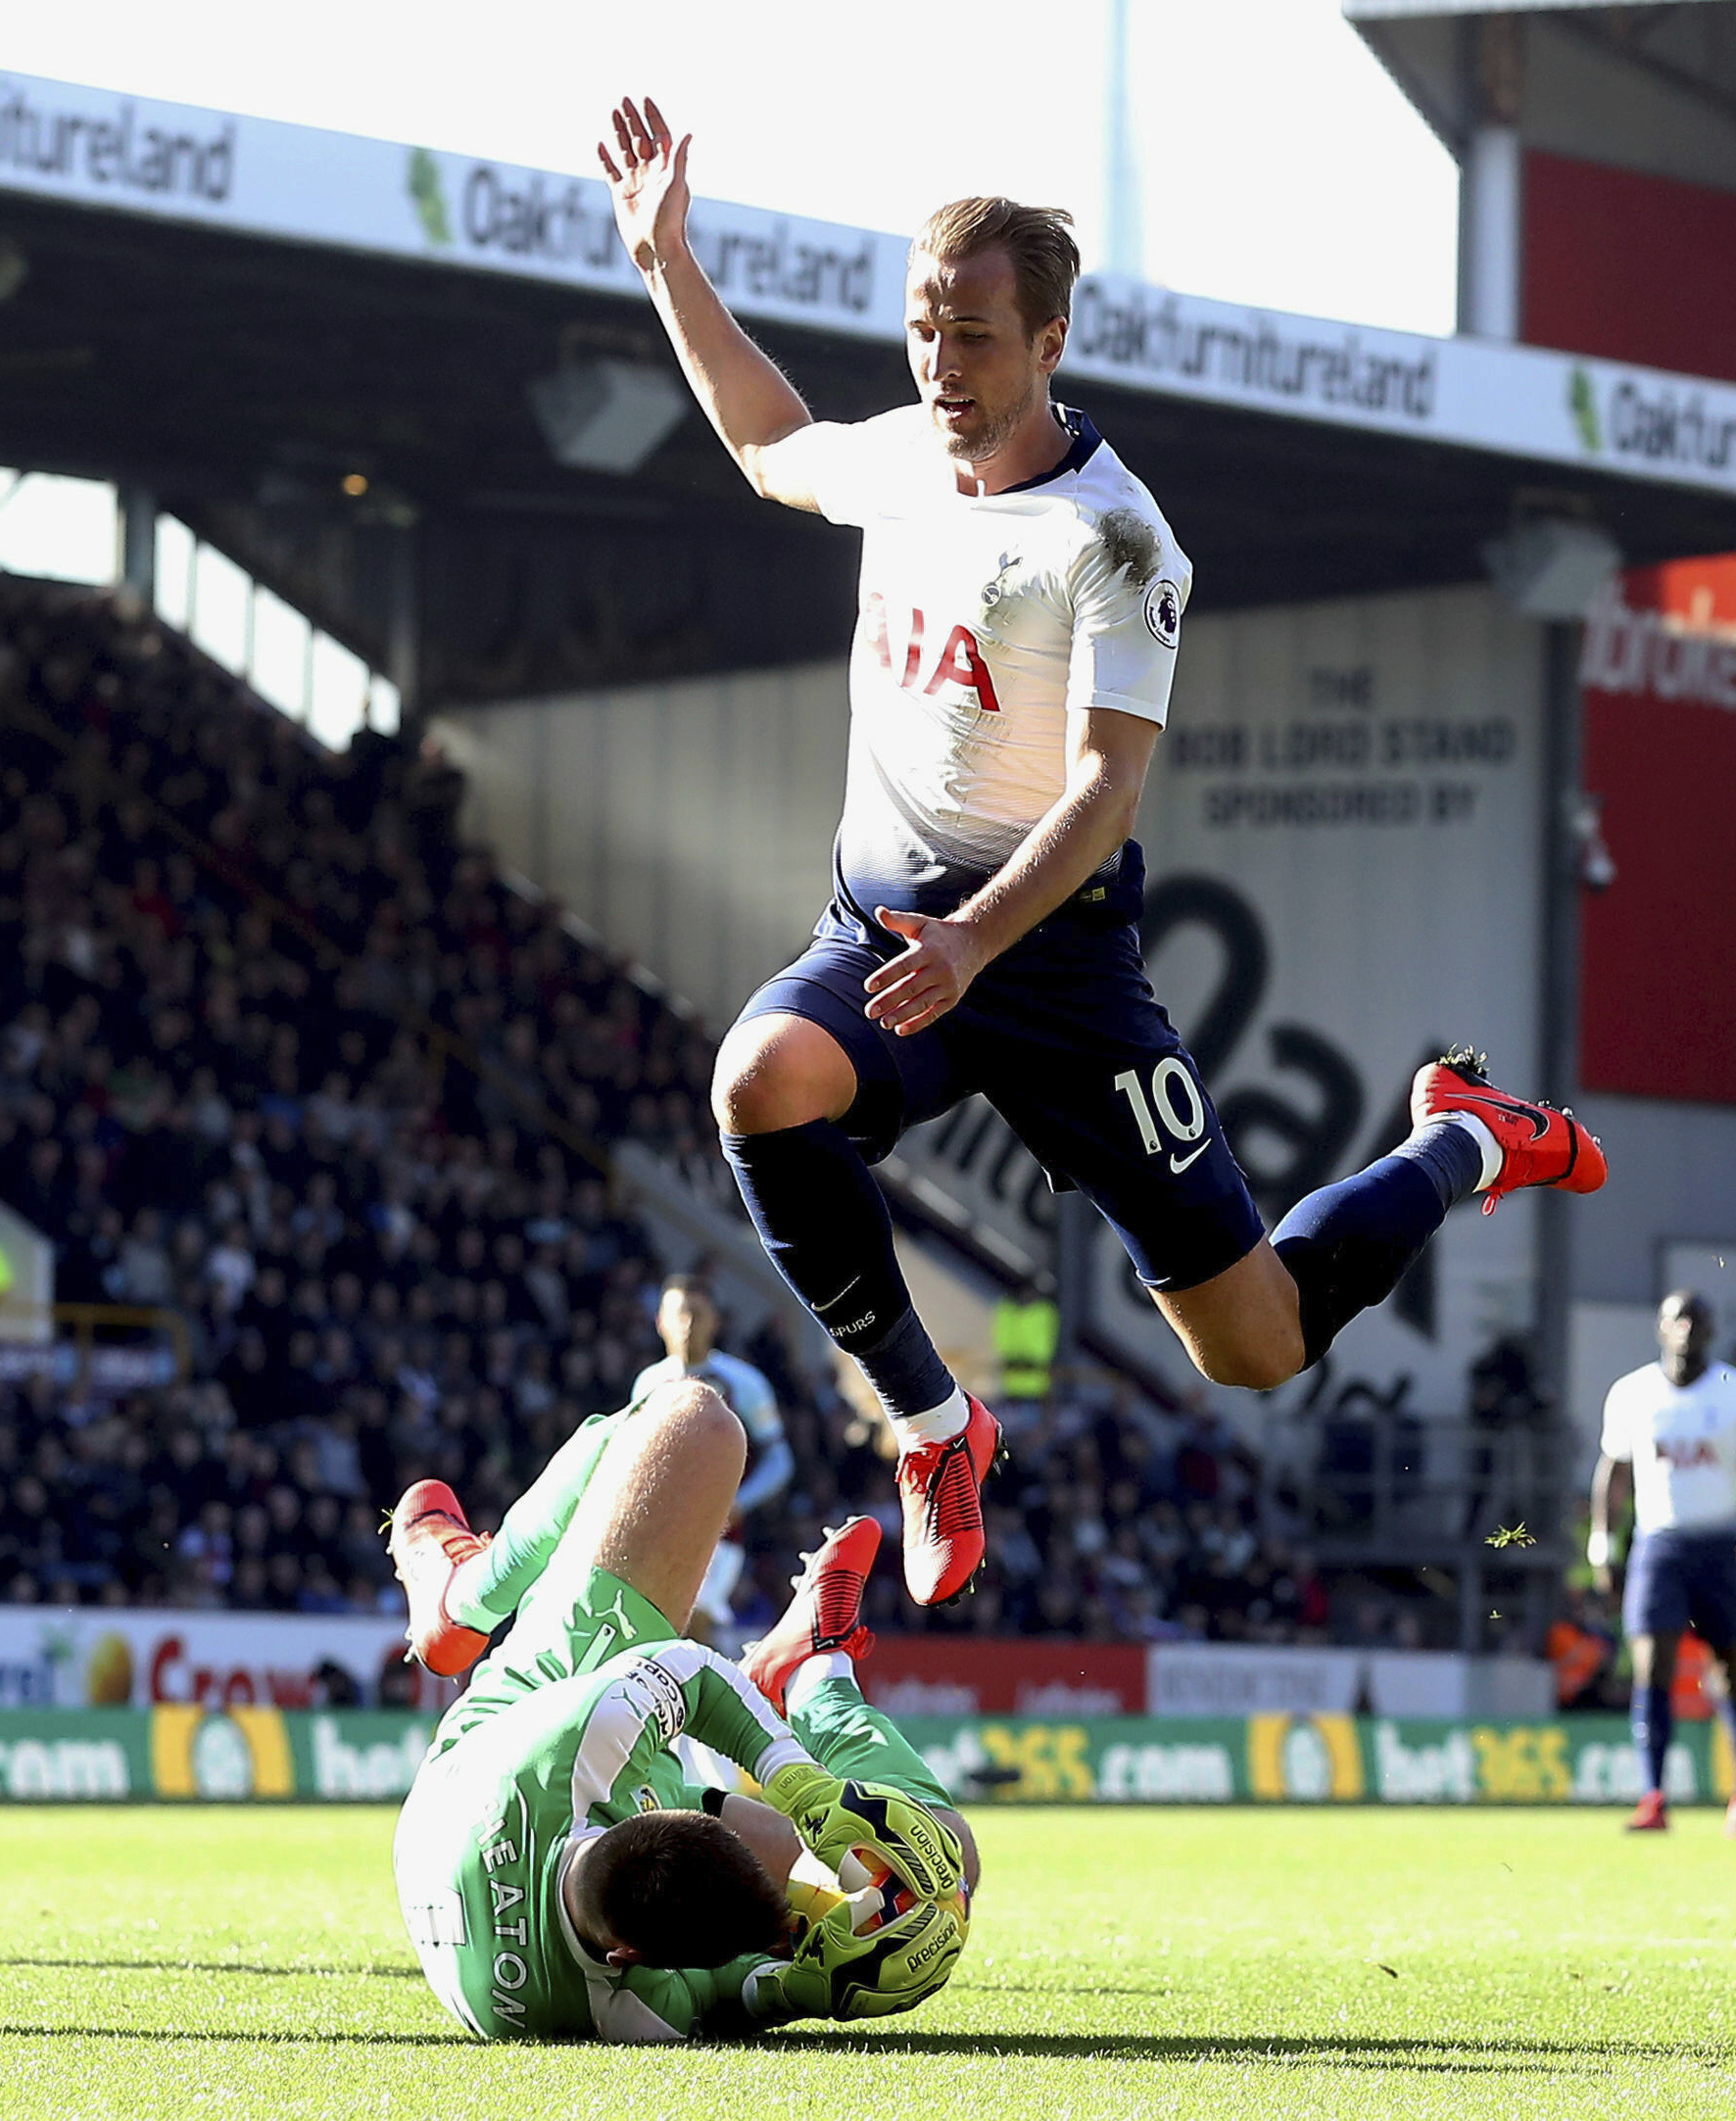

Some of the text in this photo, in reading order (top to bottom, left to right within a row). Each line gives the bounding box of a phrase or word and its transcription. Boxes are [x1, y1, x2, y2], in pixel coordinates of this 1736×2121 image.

[1380, 714, 1516, 766] STAND
[1204, 784, 1479, 828] SPONSORED BY
[1115, 1057, 1203, 1154] 10
[829, 1310, 876, 1337] SPURS
[909, 1824, 955, 1890] precision
[906, 1921, 957, 1973] precision
